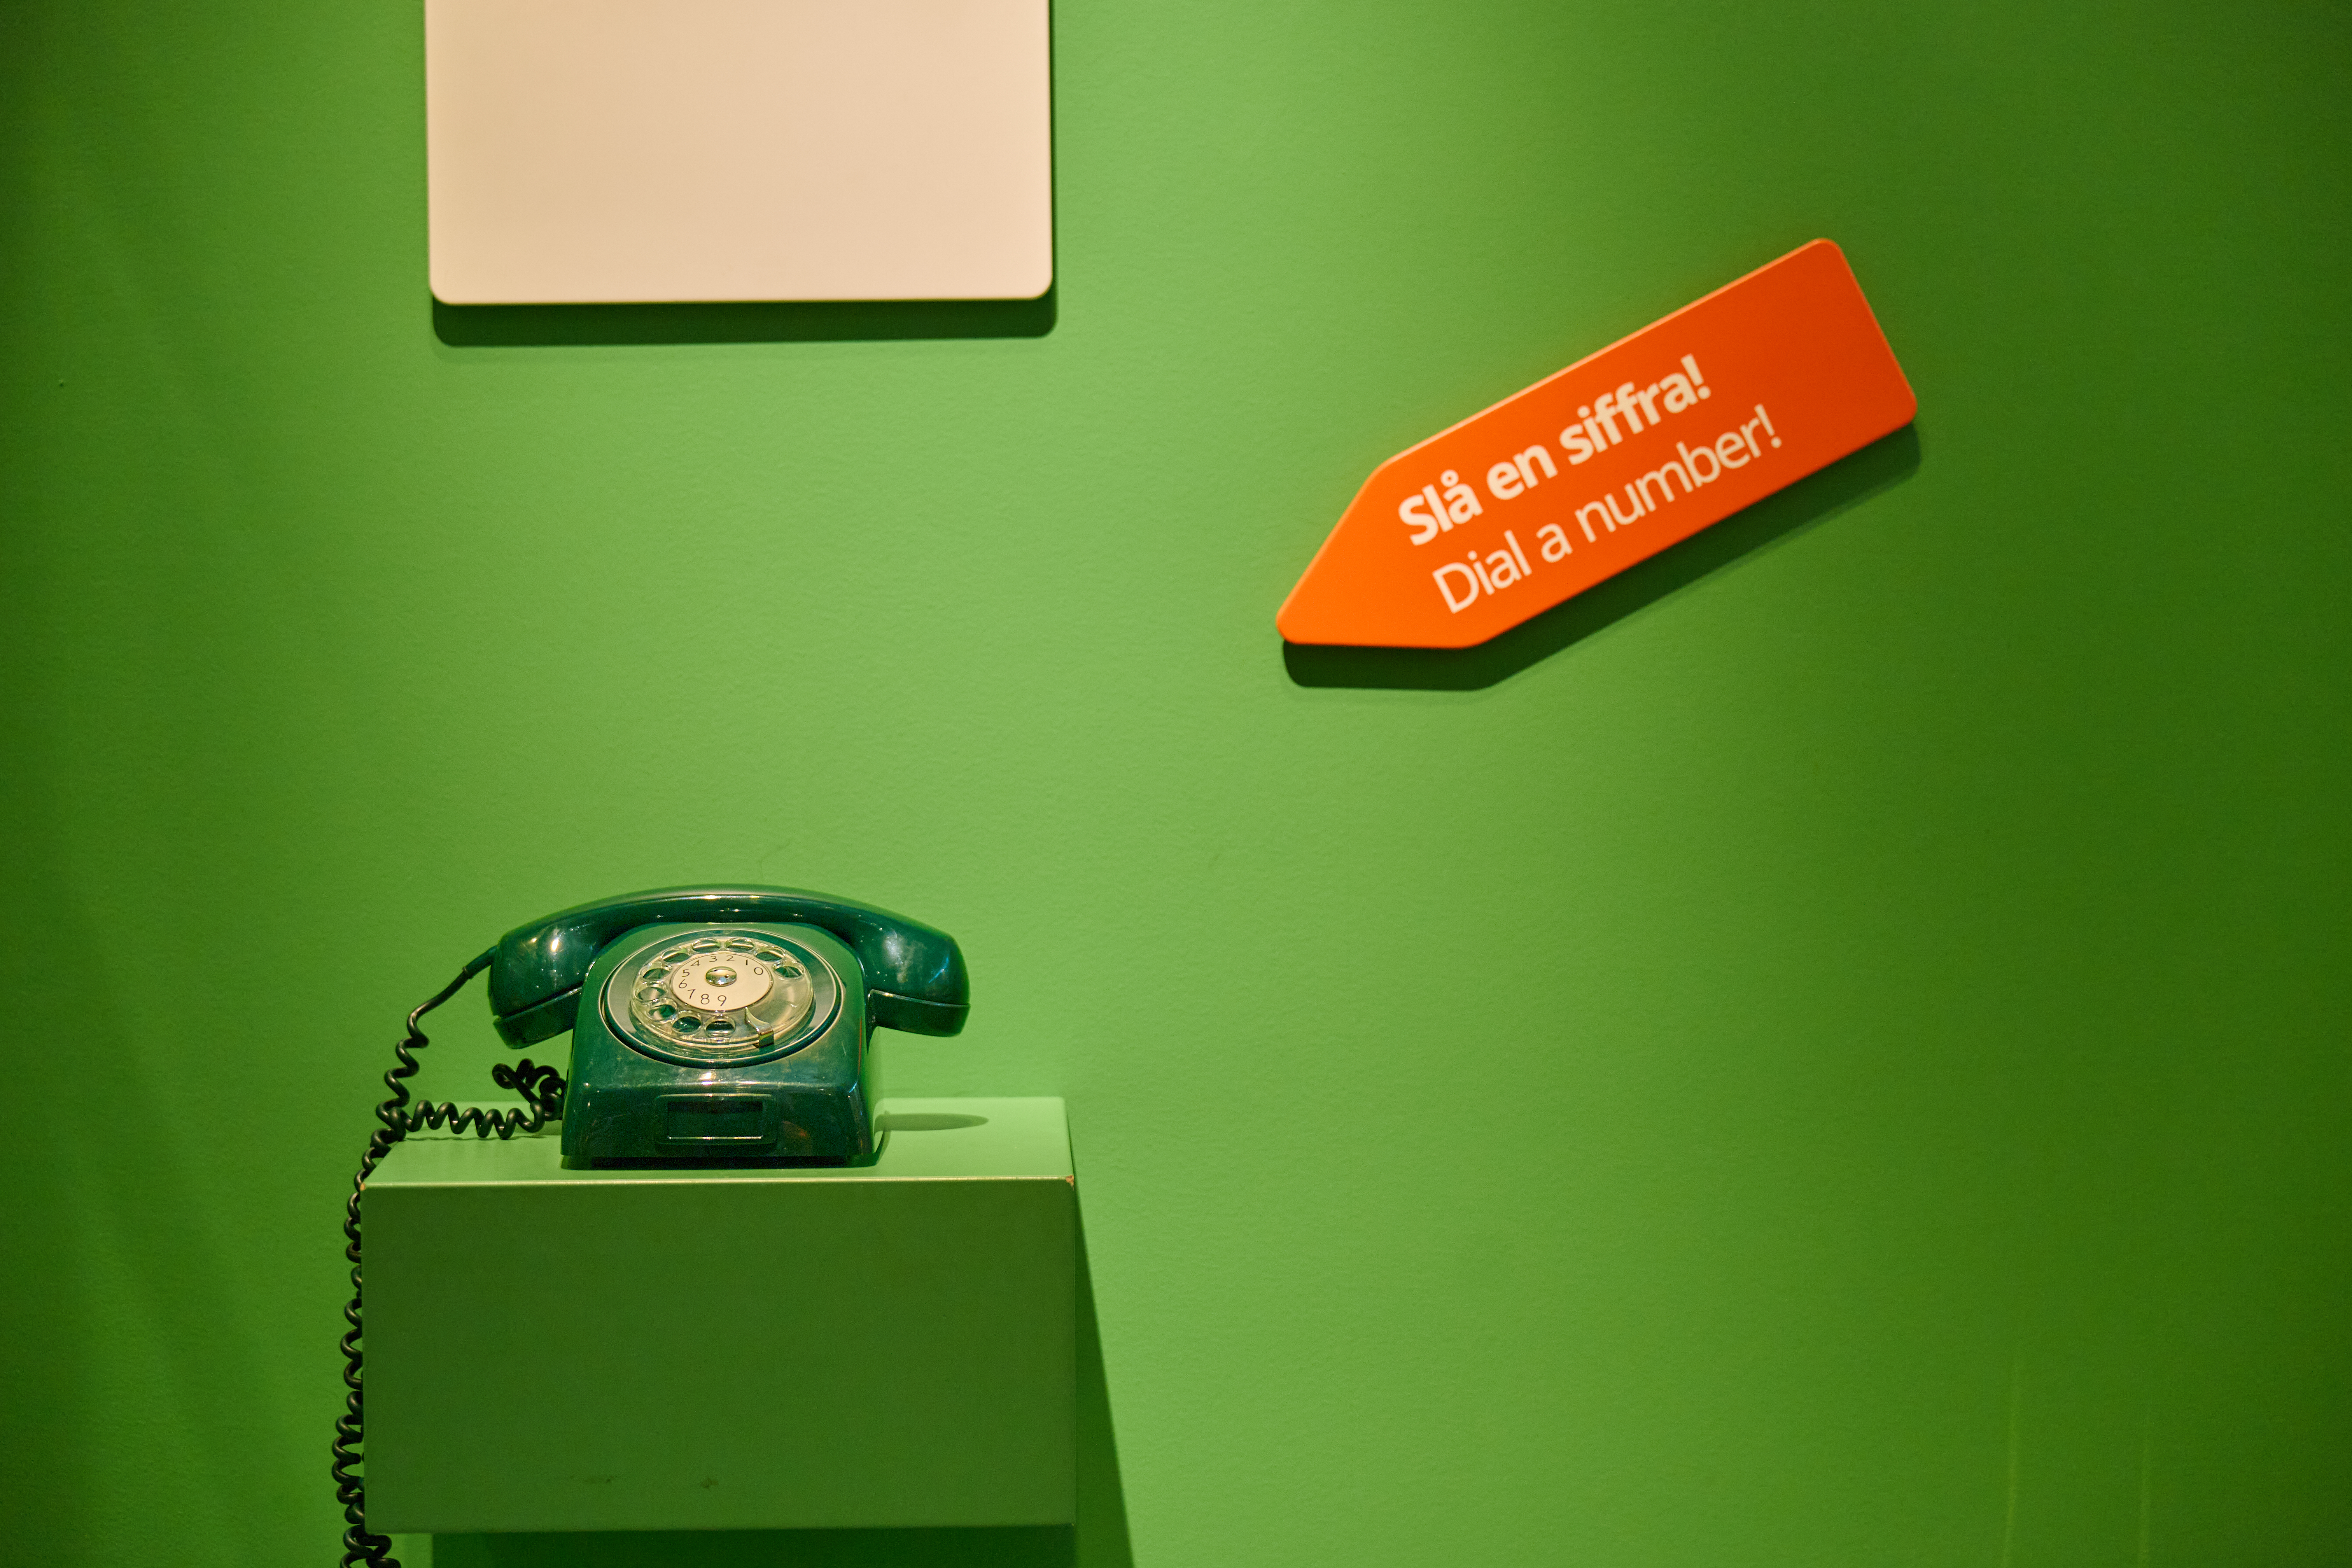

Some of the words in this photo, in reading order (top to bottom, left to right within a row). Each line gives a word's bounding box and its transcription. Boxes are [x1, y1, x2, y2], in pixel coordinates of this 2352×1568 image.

[1398, 469, 1482, 546] Slå
[1487, 445, 1558, 500] en
[1559, 354, 1710, 465] siffra!
[1432, 530, 1532, 614] Dial
[1536, 523, 1572, 563] a
[1575, 404, 1781, 542] number!
[682, 969, 690, 977] 5
[754, 967, 764, 975] 0
[678, 979, 688, 989] 6
[687, 989, 696, 999] 7
[700, 993, 710, 1005] 8
[717, 995, 727, 1006] 9
